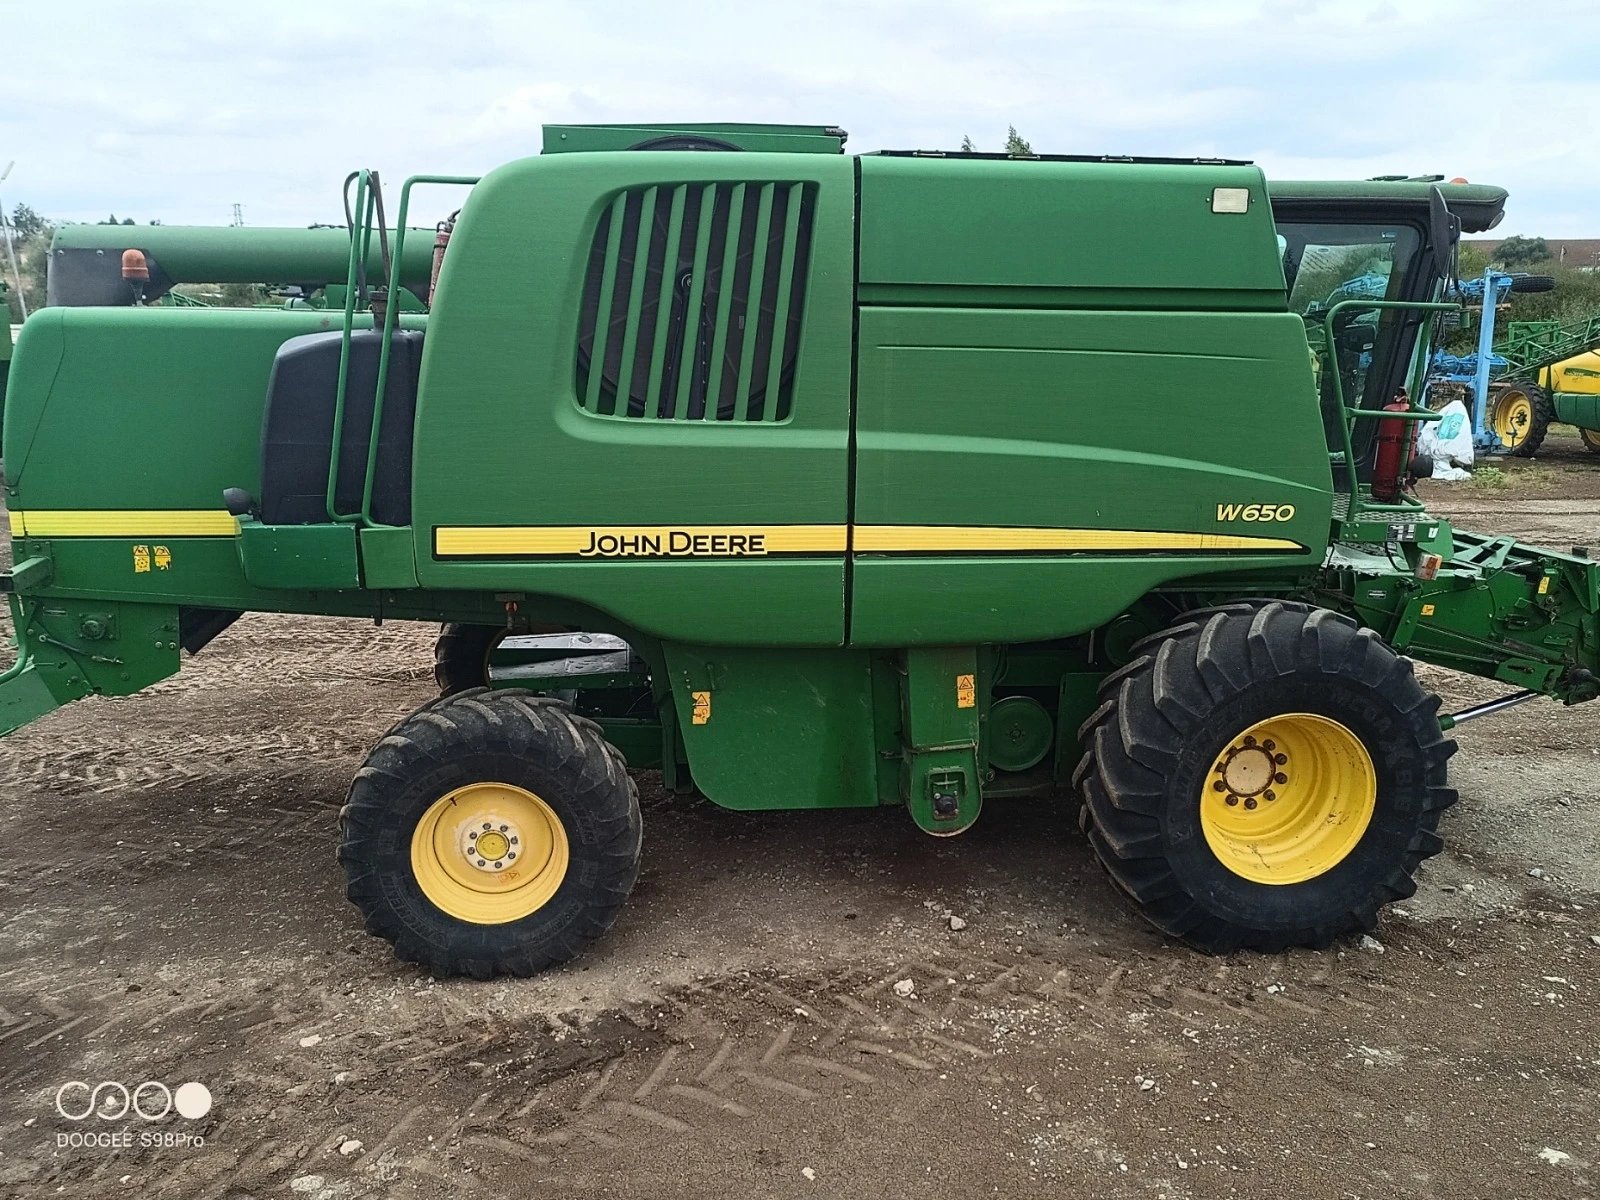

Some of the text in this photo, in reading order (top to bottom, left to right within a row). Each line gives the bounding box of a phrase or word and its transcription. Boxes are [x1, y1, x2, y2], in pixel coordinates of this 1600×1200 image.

[1216, 503, 1296, 522] W650
[579, 531, 765, 554] JOHN DEERE
